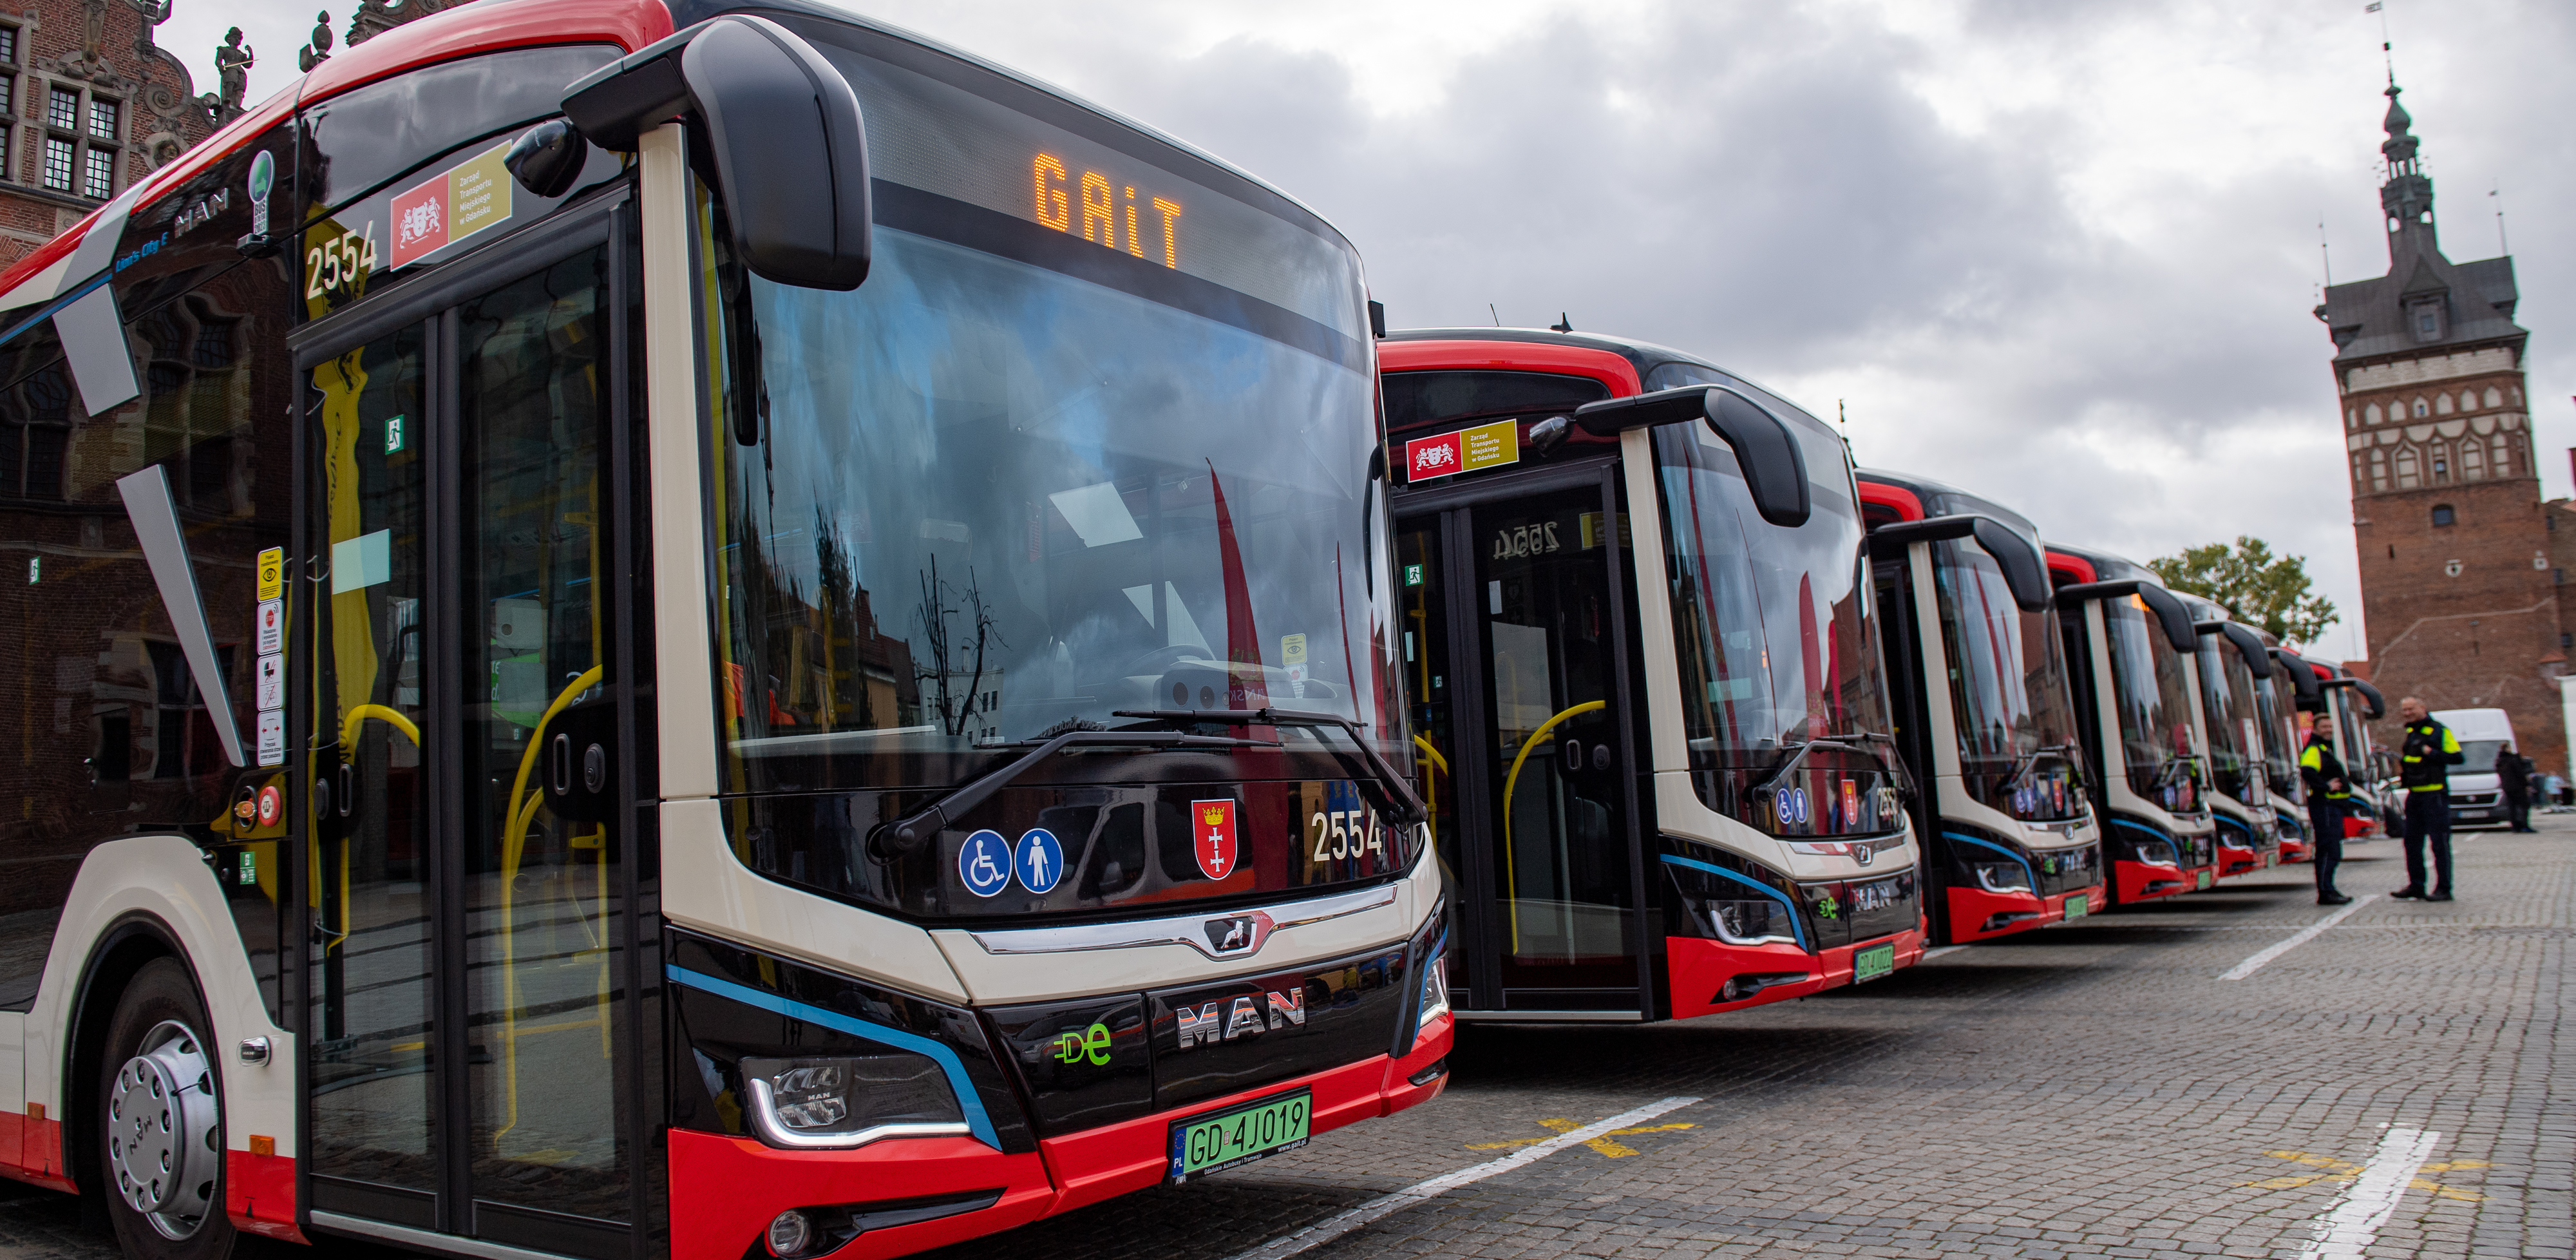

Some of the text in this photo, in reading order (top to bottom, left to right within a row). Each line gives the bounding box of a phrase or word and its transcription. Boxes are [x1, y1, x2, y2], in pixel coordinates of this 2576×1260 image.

[459, 170, 480, 187] Zarząd
[459, 179, 491, 199] Transportu
[254, 199, 266, 216] BUS
[459, 193, 491, 213] Miejskiego
[175, 188, 229, 238] MAN
[466, 205, 491, 222] Gdańsku
[307, 220, 377, 300] 2554
[1470, 433, 1488, 441] Zarząd
[1471, 438, 1500, 448] Transportu
[1471, 446, 1499, 455] Miejskiego
[1477, 453, 1500, 461] Gdańsku
[1311, 809, 1382, 862] 2554
[1175, 987, 1306, 1049] MAN
[808, 1092, 831, 1101] MAN
[129, 1115, 153, 1155] MAN
[1191, 1101, 1303, 1165] GD 4J019
[1278, 1138, 1307, 1153] www.gait.pl
[1173, 1157, 1184, 1169] PL
[1204, 1165, 1222, 1176] Gdańskie
[1223, 1160, 1242, 1170] Autobusy
[1244, 1152, 1262, 1163] Tramwaje
